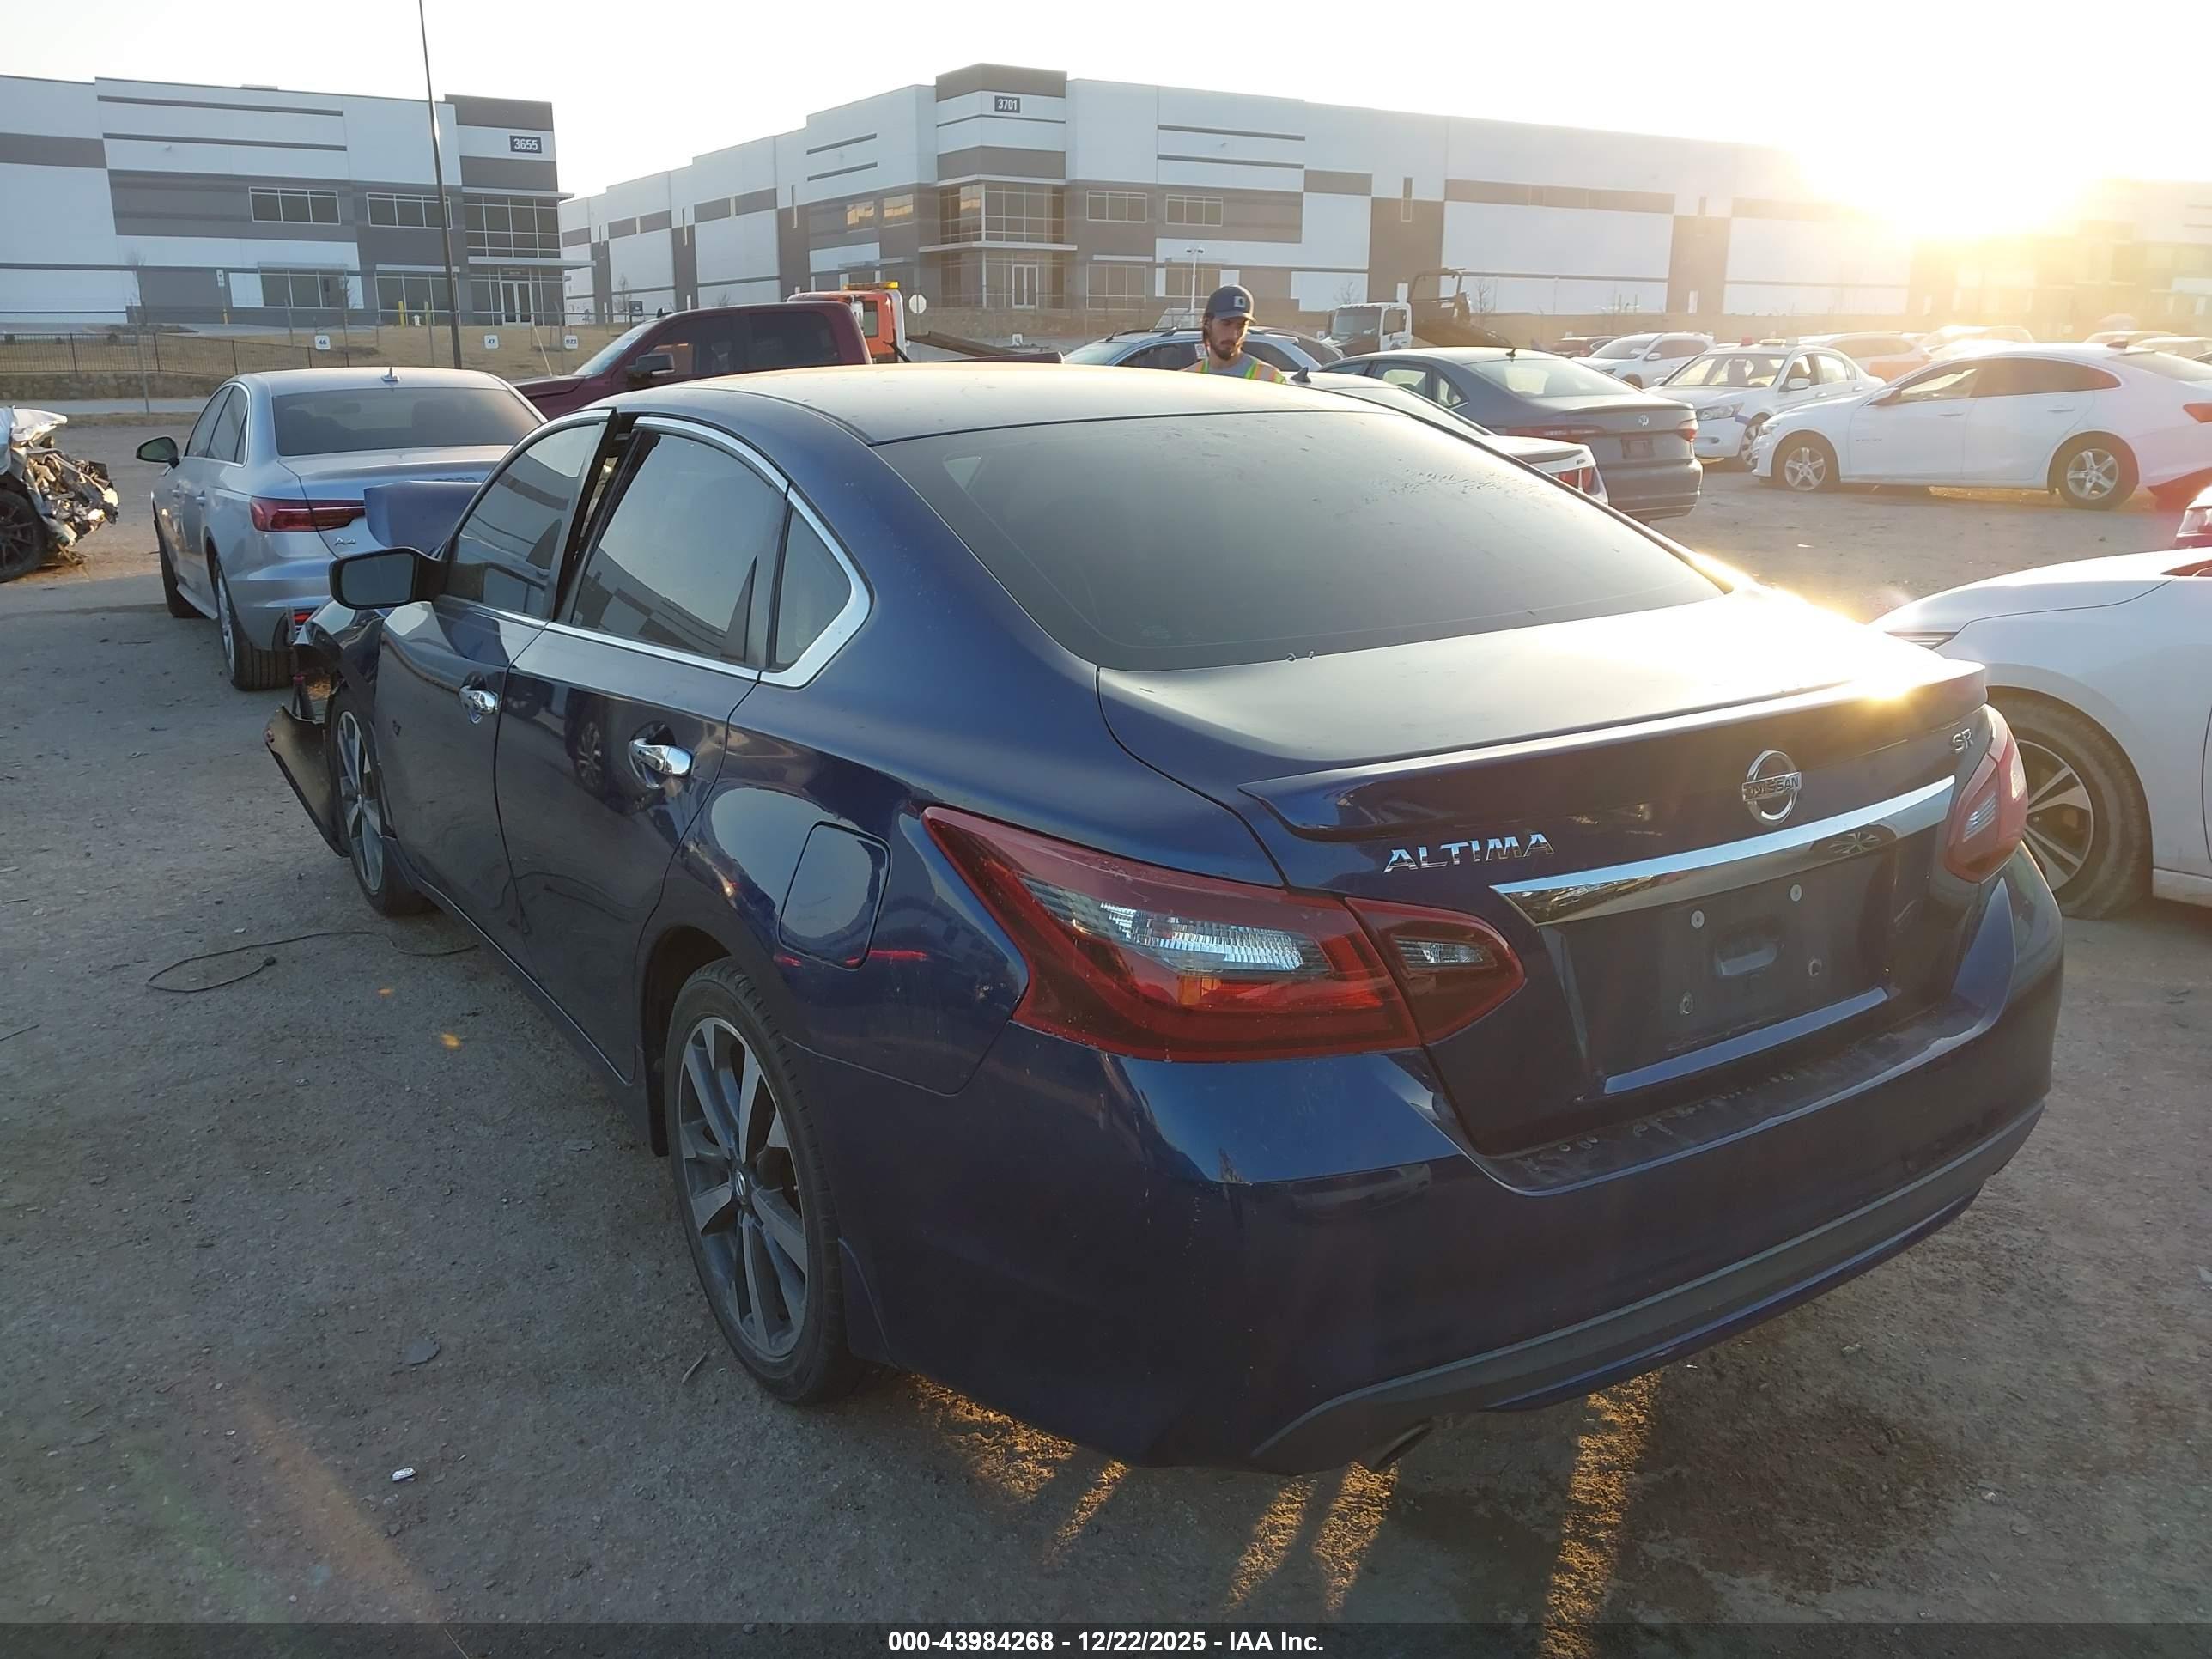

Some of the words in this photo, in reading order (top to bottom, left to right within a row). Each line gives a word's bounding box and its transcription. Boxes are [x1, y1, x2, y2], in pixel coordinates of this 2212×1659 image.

[997, 98, 1018, 111] 3701
[514, 137, 538, 151] 3655
[1953, 728, 1973, 751] SR
[1750, 775, 1800, 796] NISSAN
[1382, 832, 1555, 873] ALTIMA
